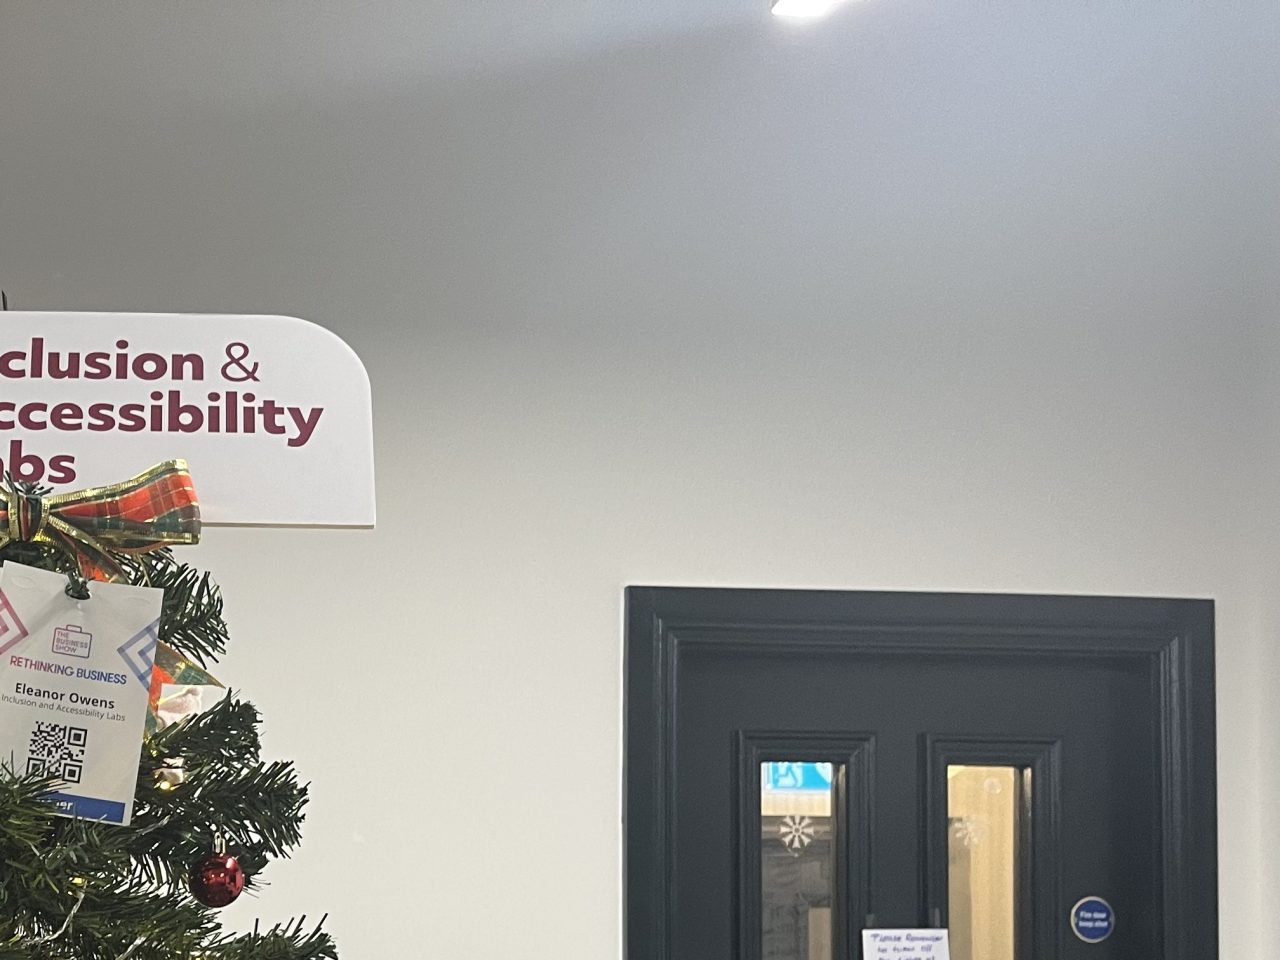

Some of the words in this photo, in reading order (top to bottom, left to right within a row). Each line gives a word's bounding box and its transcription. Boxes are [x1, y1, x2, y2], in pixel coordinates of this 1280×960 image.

[221, 342, 260, 382] &
[56, 638, 88, 649] BUSINESS
[57, 631, 70, 639] THE
[55, 645, 76, 653] SHOW
[10, 655, 74, 676] RETHINKING
[76, 668, 127, 685] BUSINESS
[1, 694, 37, 707] Inclusion
[38, 702, 54, 710] and
[56, 704, 105, 720] Accessibility
[106, 711, 126, 721] Labs
[15, 682, 65, 701] Eleanor
[69, 692, 115, 709] Owens
